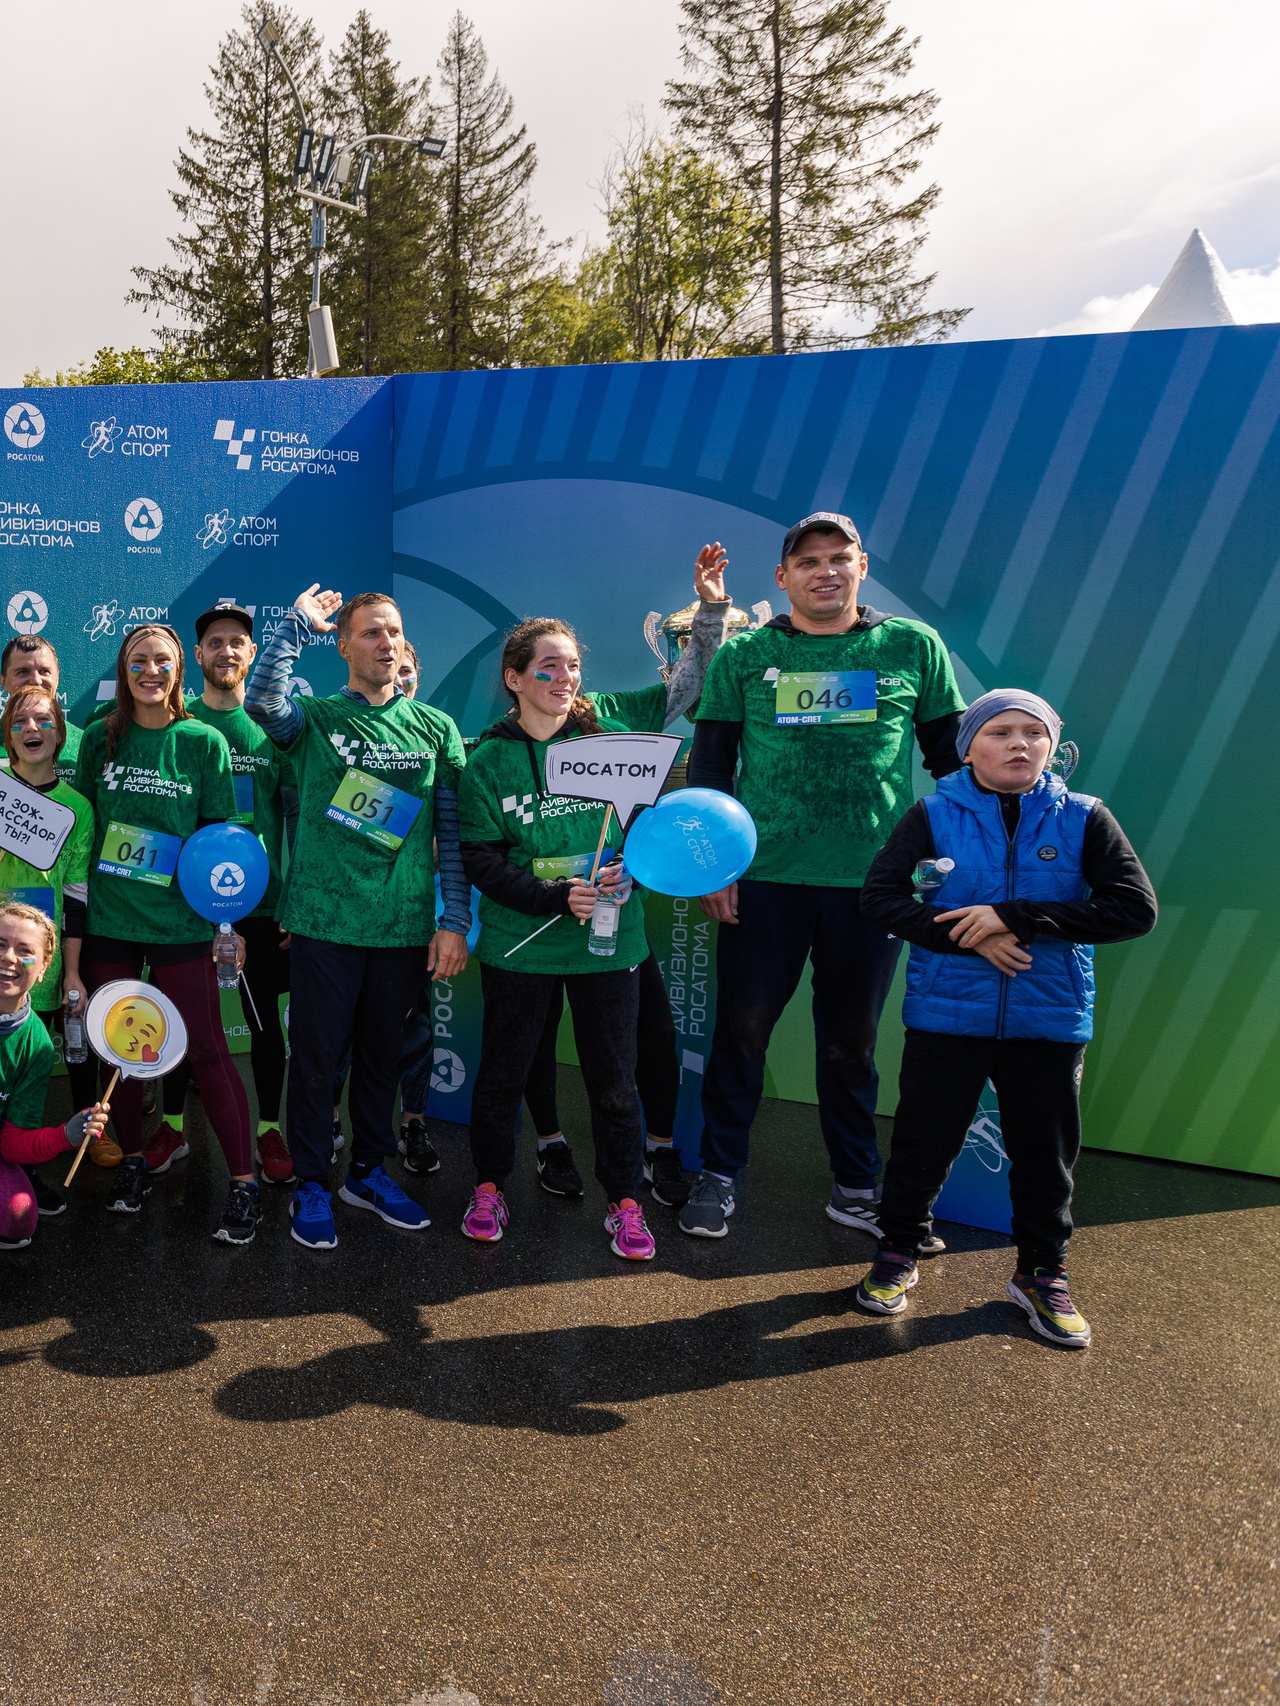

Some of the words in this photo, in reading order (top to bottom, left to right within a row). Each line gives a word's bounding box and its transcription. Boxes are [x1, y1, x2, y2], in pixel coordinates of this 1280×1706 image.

[127, 425, 168, 441] АТОМ
[261, 430, 309, 445] ГОНКА
[6, 452, 45, 462] РОСАТОМ
[121, 441, 171, 458] СПОРТ
[261, 445, 360, 463] ДИВИЗИОНОВ
[261, 460, 337, 475] РОСАТОМА
[238, 516, 277, 531] АТОМ
[232, 532, 280, 547] СПОРТ
[127, 546, 162, 554] РОСАТОМ
[128, 606, 169, 620] АТОМ
[796, 688, 853, 710] 046
[364, 741, 400, 751] ГОНКА
[362, 751, 436, 761] ДИВИЗИОНОВ
[126, 766, 161, 778] ГОНКА
[362, 760, 421, 770] РОСАТОМА
[560, 761, 657, 778] РОСАТОМ
[122, 783, 178, 798] РОСАТОМА
[124, 777, 193, 795] ДИВИЗИОНОВ
[11, 798, 44, 821] ЗОЖ-
[349, 791, 395, 826] 051
[540, 801, 606, 819] РОСАТОМА
[4, 822, 31, 845] ТЫ?!
[116, 841, 158, 869] 041
[687, 838, 707, 871] СПОРТ
[700, 838, 718, 867] АТОМ
[670, 897, 689, 1035] ДИВИЗИОНО
[689, 921, 710, 1037] РОСАТОМА
